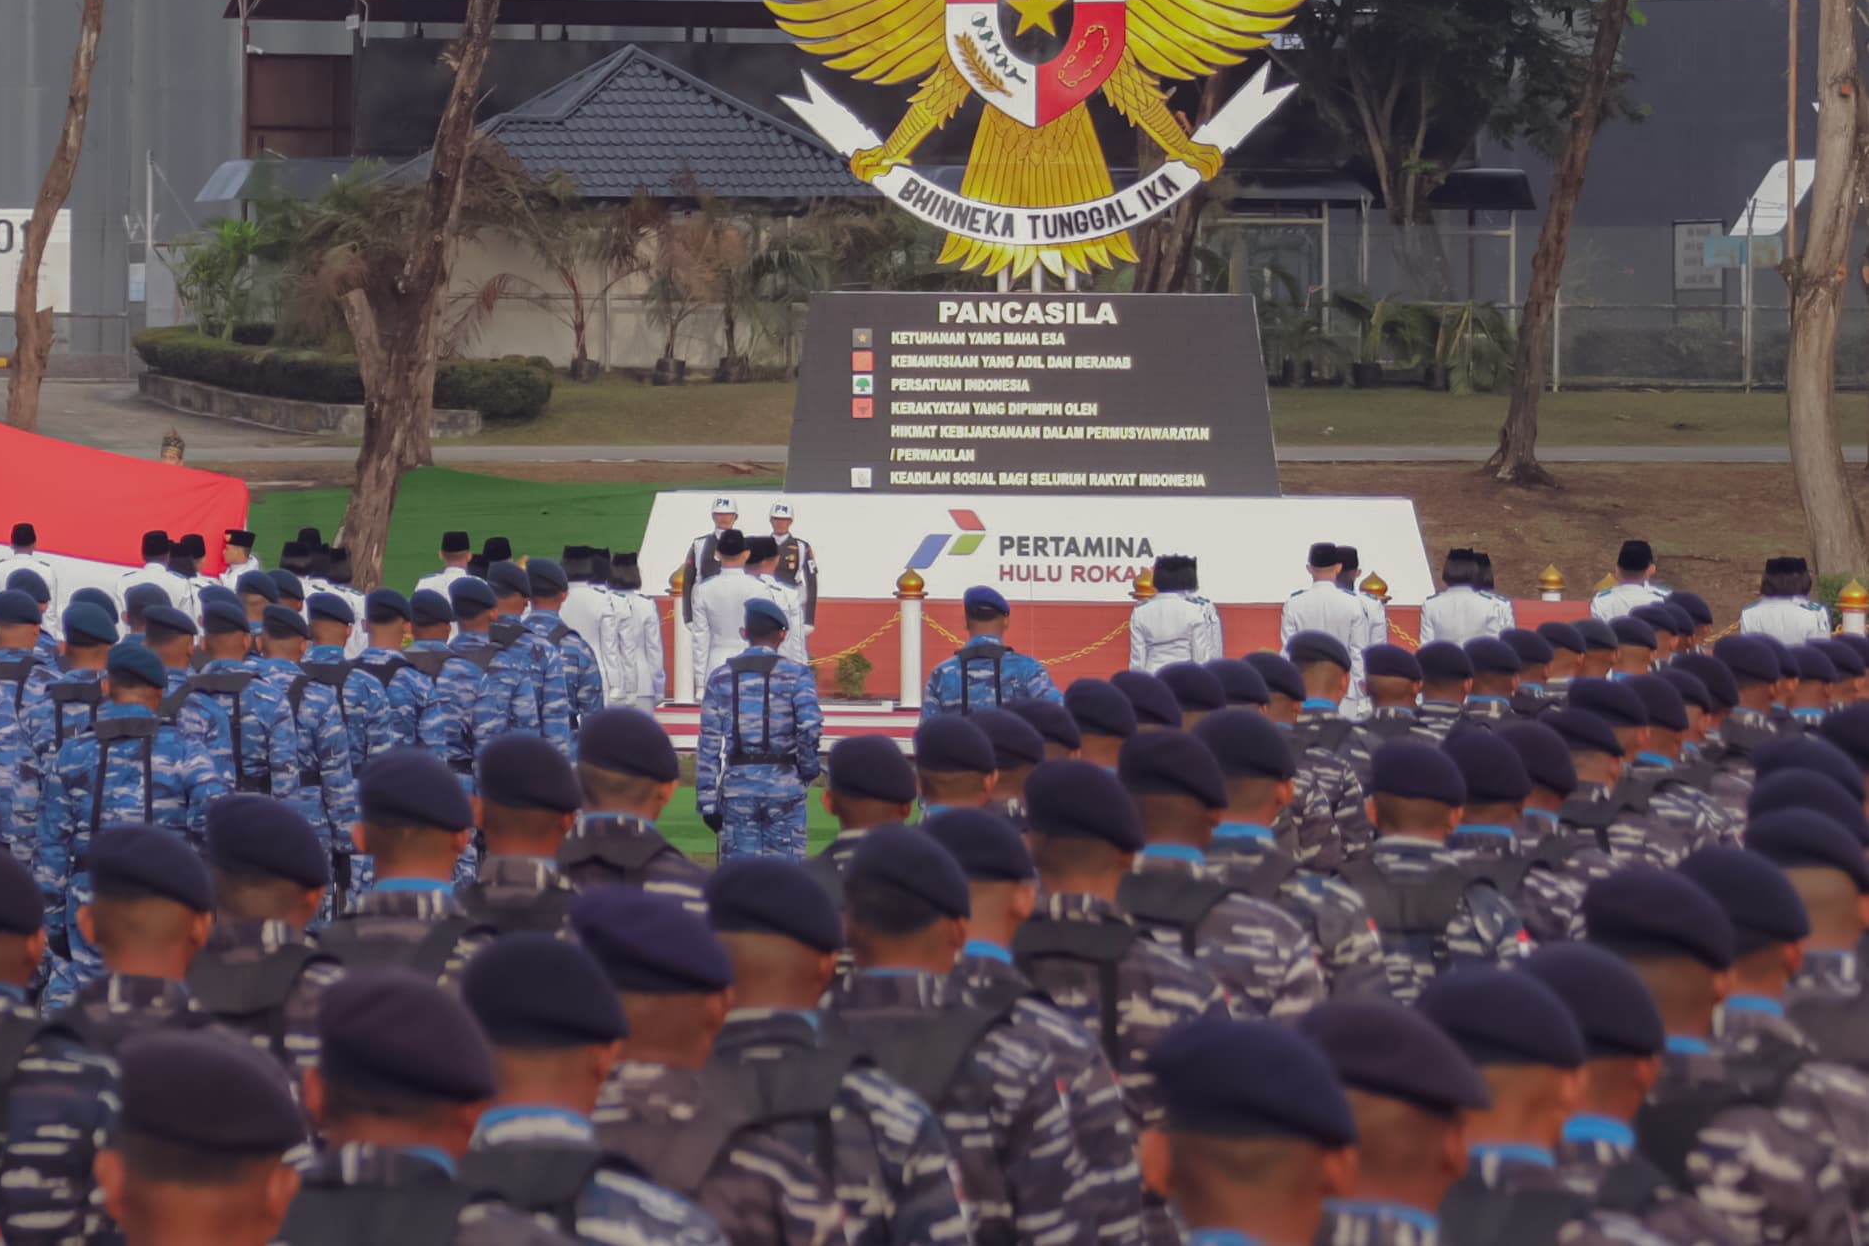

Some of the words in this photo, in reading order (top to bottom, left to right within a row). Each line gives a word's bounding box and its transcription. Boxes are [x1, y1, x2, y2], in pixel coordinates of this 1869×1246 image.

[897, 176, 1015, 239] BHINNEKA
[1027, 198, 1138, 240] TUNGGAL
[1136, 172, 1181, 210] IKA
[938, 301, 1118, 324] PANCASILA
[890, 331, 966, 345] KETUHANAN
[968, 332, 1001, 345] YANG
[1003, 332, 1039, 346] MAHA
[1041, 333, 1065, 346] ESA
[890, 355, 978, 368] KEMANUSIAAN
[981, 356, 1015, 369] YANG
[1016, 356, 1045, 369] ADIL
[1047, 356, 1072, 369] DAN
[1074, 356, 1132, 369] BERADAB
[890, 378, 962, 391] PERSATUAN
[964, 379, 1030, 392] INDONESIA
[890, 401, 970, 415] KERAKYATAN
[972, 402, 1006, 415] YANG
[1007, 402, 1063, 416] DIPIMPIN
[1064, 403, 1098, 416] OLEH
[890, 425, 938, 438] HIKMAT
[939, 426, 1041, 439] KEBIJAKSANAAN
[1042, 426, 1084, 440] DALAM
[1086, 427, 1210, 441] PERMUSYAWARATAN
[896, 448, 976, 462] PERWAKILAN
[890, 471, 951, 484] KEADILAN
[953, 472, 997, 485] SOSIAL
[998, 472, 1028, 486] BAGI
[1030, 472, 1086, 487] SELURUH
[1089, 473, 1138, 486] RAKYAT
[1139, 474, 1206, 487] INDONESIA
[999, 536, 1155, 558] PERTAMINA
[998, 564, 1062, 583] HULU
[1070, 564, 1153, 583] ROKA
